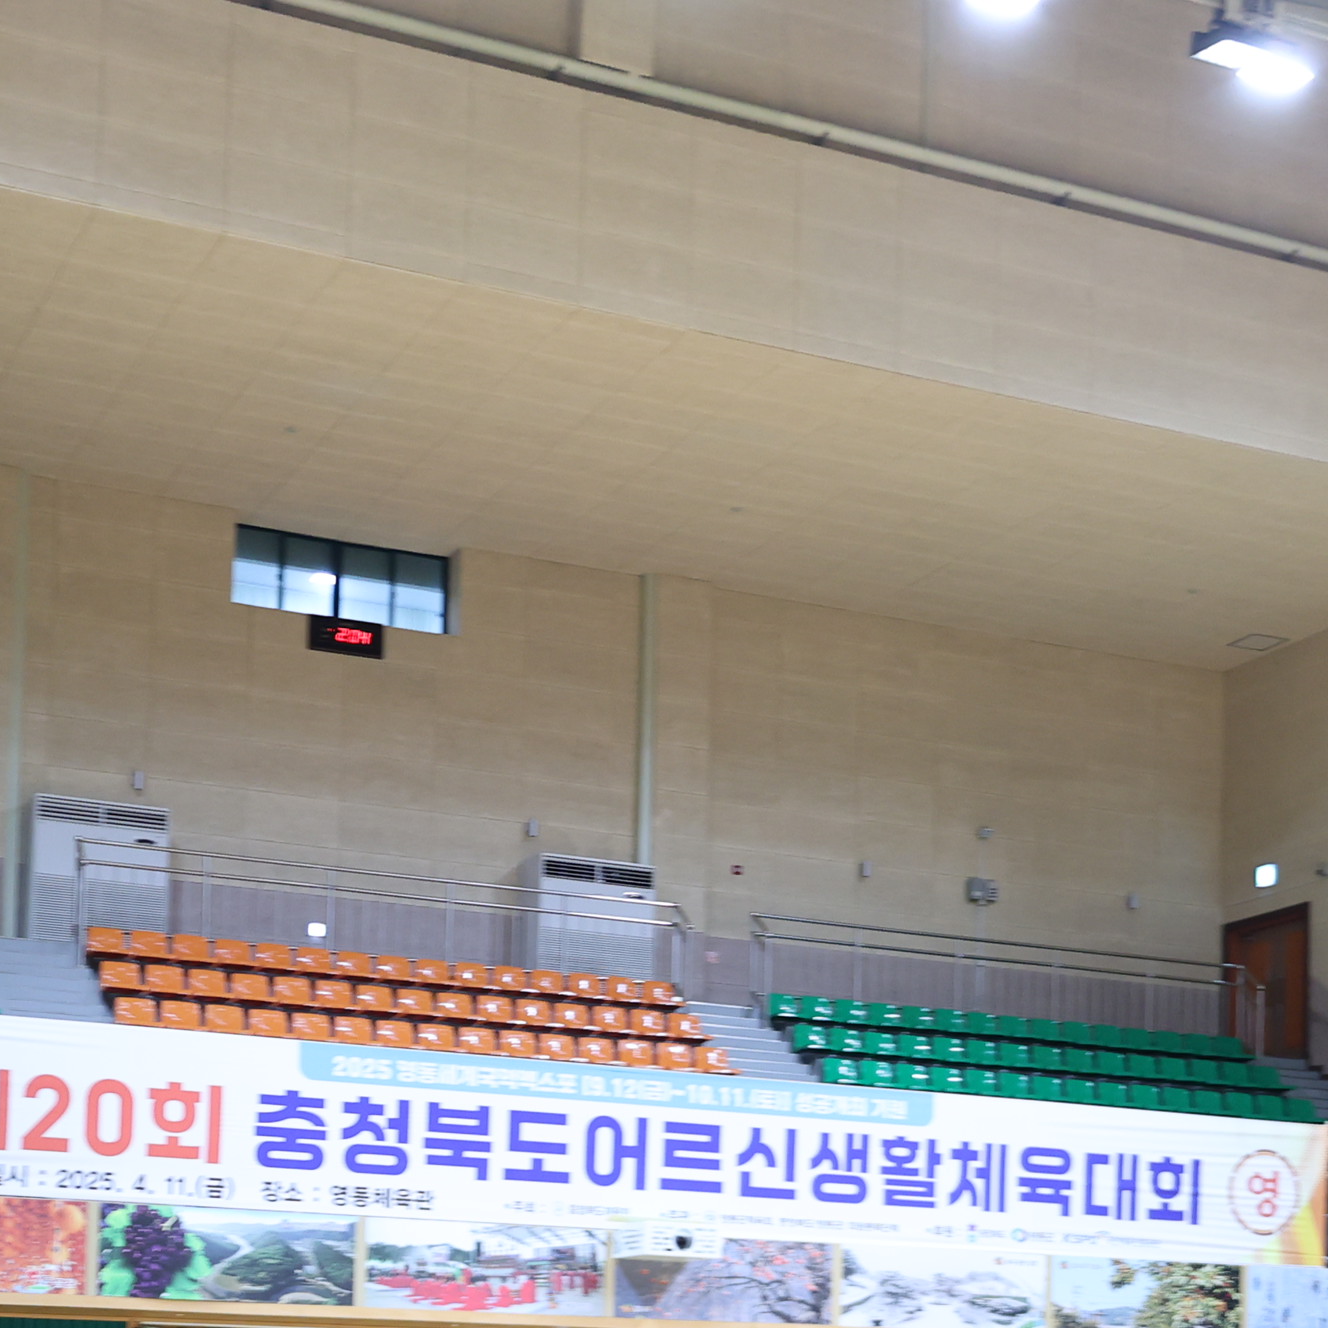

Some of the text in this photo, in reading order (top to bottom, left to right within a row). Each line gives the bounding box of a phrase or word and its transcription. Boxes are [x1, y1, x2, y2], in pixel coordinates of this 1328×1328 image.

[331, 1055, 394, 1081] 2025
[255, 1089, 1200, 1226] 충청북도어르신생활체육대회
[56, 1169, 124, 1193] 2025.
[262, 1180, 302, 1203] 장소
[330, 1184, 435, 1212] 영동체육관
[1248, 1170, 1280, 1218] 영
